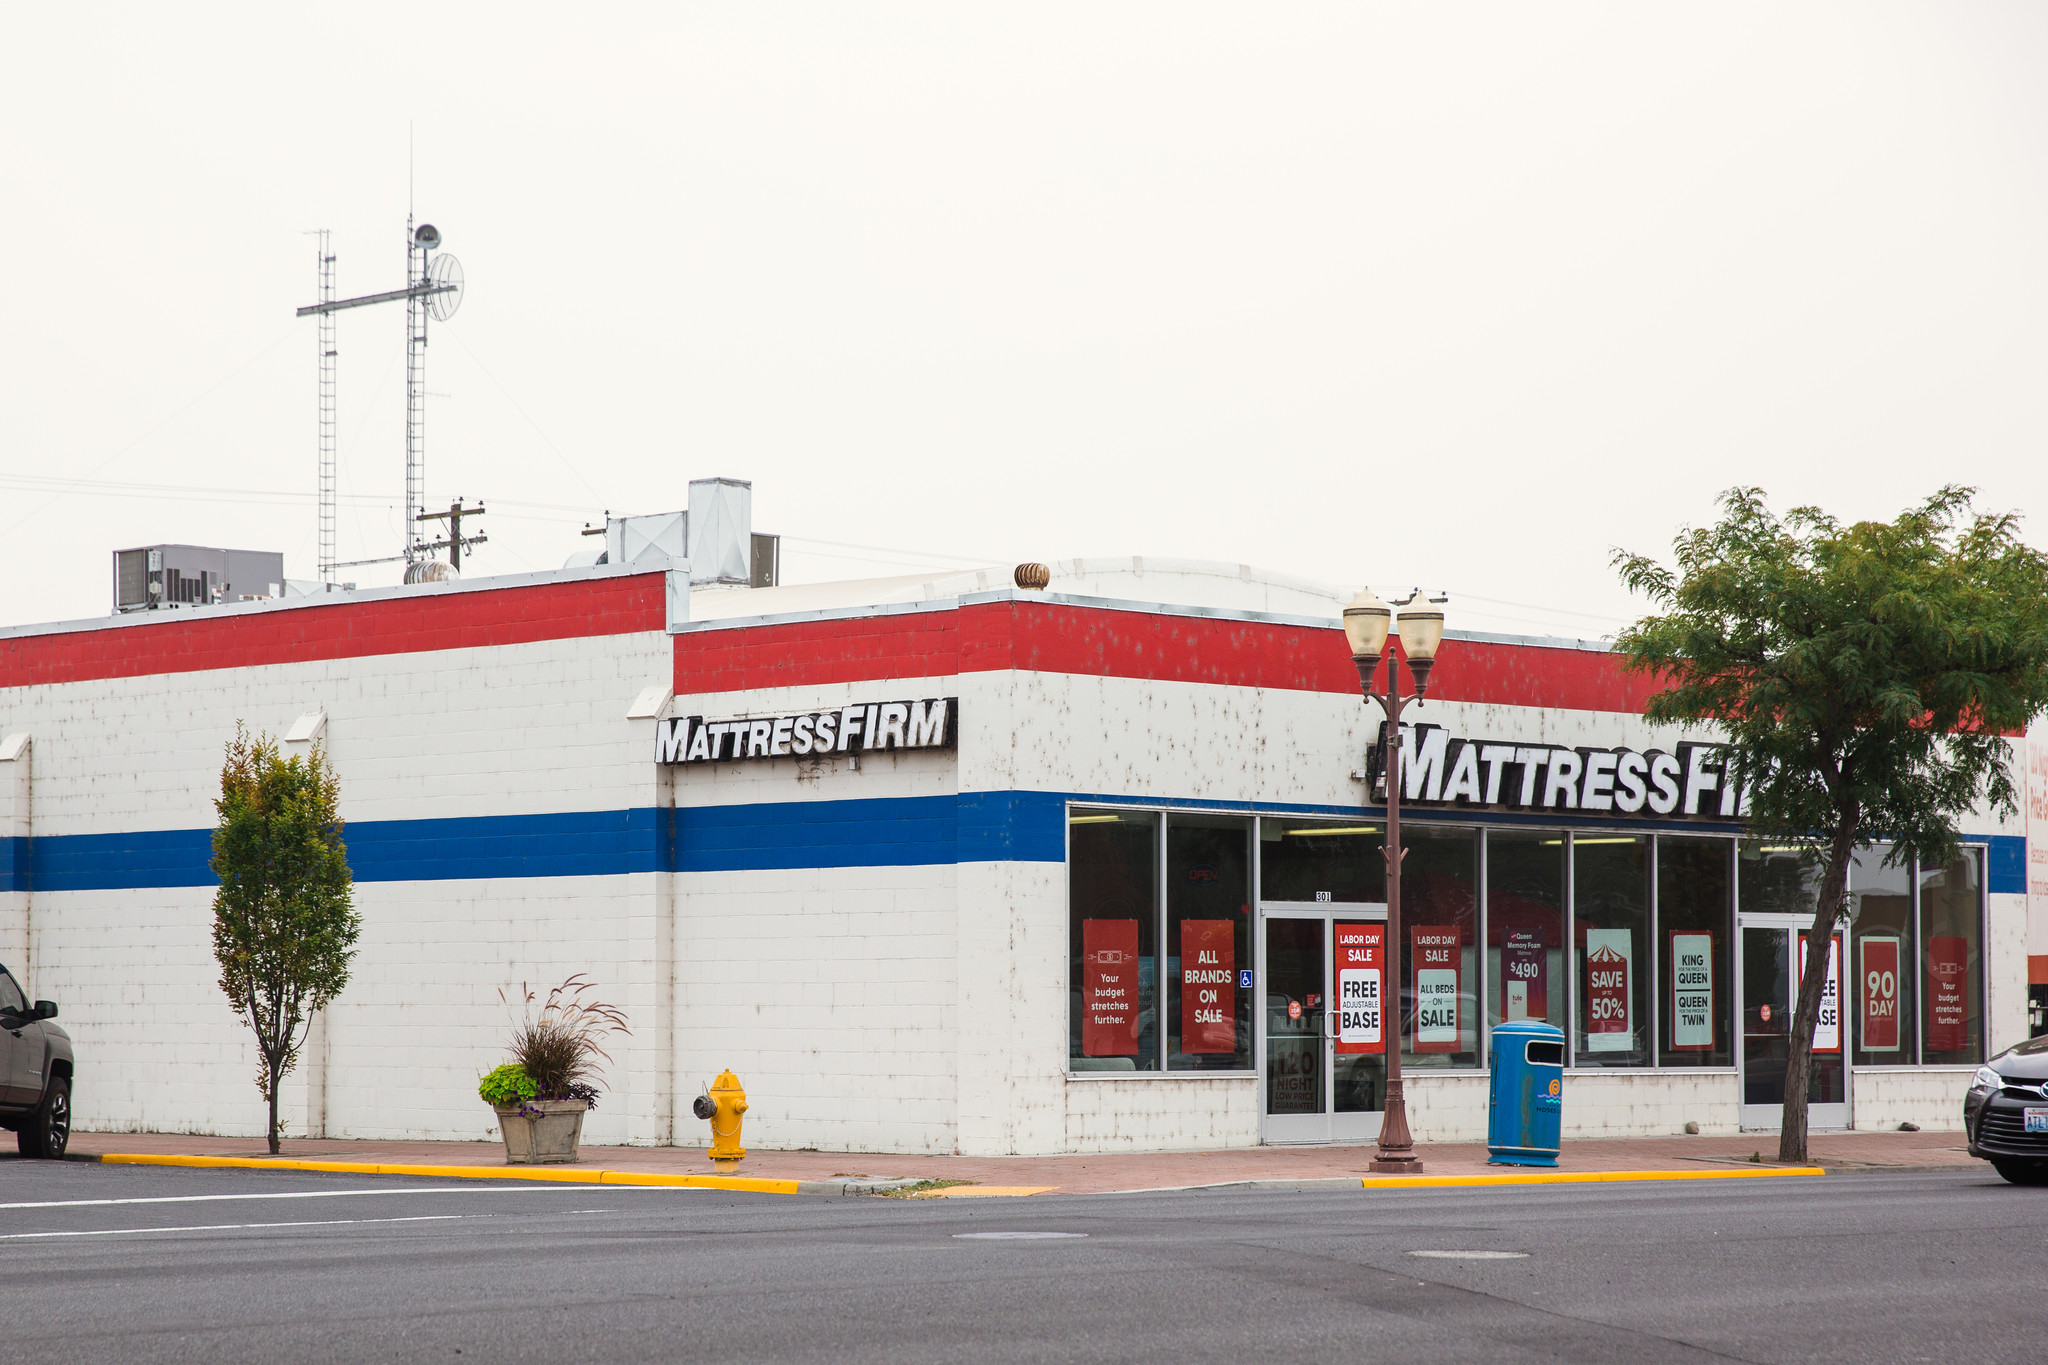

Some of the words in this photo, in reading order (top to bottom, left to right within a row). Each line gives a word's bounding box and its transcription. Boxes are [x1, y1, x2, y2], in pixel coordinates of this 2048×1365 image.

[1189, 869, 1218, 880] OPEN
[1316, 892, 1331, 902] 301
[1340, 935, 1364, 944] LABOR
[1365, 935, 1380, 944] DAY
[1417, 936, 1441, 945] LABOR
[1442, 936, 1456, 945] DAY
[1507, 942, 1527, 950] Memory
[1198, 950, 1219, 964] ALL
[1347, 949, 1372, 962] SALE
[1425, 949, 1449, 962] SALE
[1682, 954, 1704, 966] KING
[1510, 961, 1538, 978] $490
[1101, 973, 1119, 983] Your
[1184, 970, 1232, 984] BRANDS
[1591, 971, 1623, 988] SAVE
[1678, 973, 1708, 984] QUEEN
[1343, 981, 1378, 998] FREE
[1420, 984, 1434, 994] ALL
[1435, 984, 1455, 994] BEDS
[1867, 970, 1895, 999] 90
[1942, 982, 1956, 990] Your
[1095, 987, 1125, 998] budget
[1199, 989, 1217, 1003] ON
[1938, 993, 1960, 1003] budget
[1091, 1001, 1129, 1011] stretches
[1342, 1001, 1379, 1009] ADJUSTABLE
[1432, 997, 1443, 1006] ON
[1678, 996, 1708, 1008] QUEEN
[1592, 997, 1625, 1020] 50%
[1869, 1000, 1895, 1016] DAY
[1935, 1005, 1962, 1013] stretches
[1094, 1015, 1125, 1025] further.
[1194, 1009, 1223, 1023] SALE
[1342, 1011, 1379, 1029] BASE
[1420, 1009, 1455, 1027] SALE
[1682, 1014, 1705, 1026] TWIN
[1278, 1051, 1314, 1075] 120
[1277, 1077, 1314, 1091] NIGHT
[1275, 1092, 1293, 1100] LOW
[1293, 1092, 1314, 1101] PRICE
[1274, 1101, 1314, 1110] GUARANTEE
